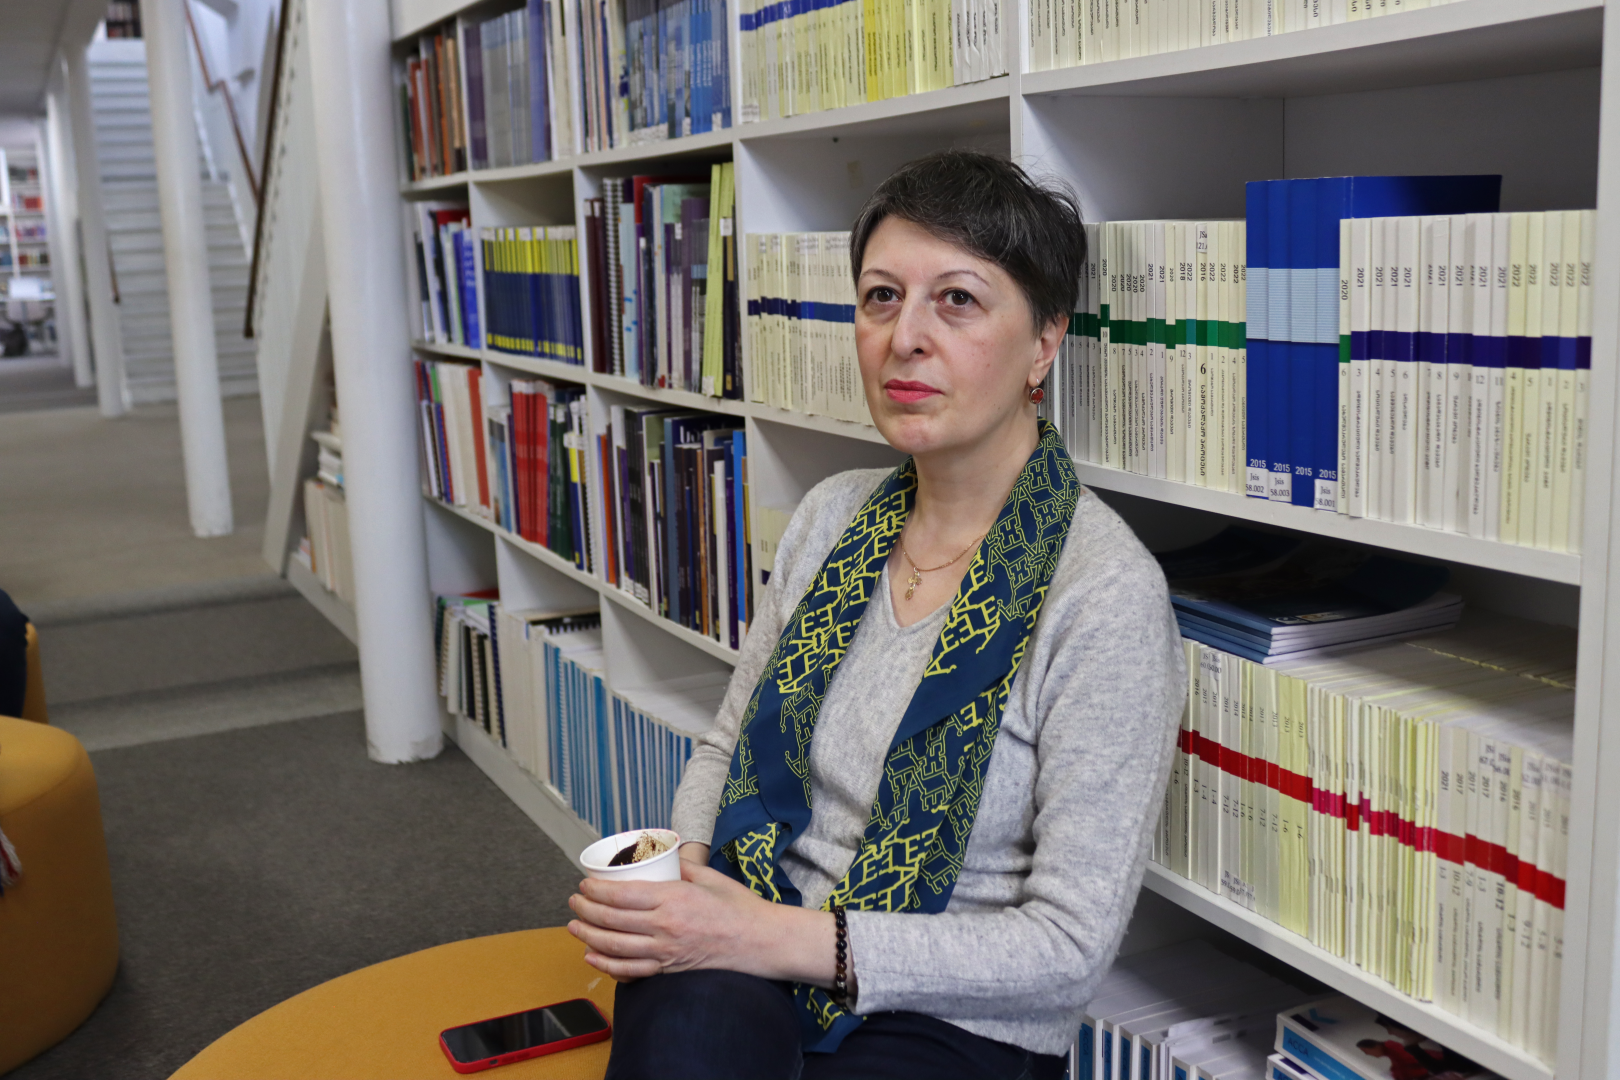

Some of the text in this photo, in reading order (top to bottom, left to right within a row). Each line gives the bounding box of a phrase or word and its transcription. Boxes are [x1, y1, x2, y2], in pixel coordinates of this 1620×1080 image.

[1375, 267, 1383, 287] 2021
[1404, 267, 1412, 287] 2021
[1438, 265, 1446, 286] 2021
[1455, 265, 1464, 286] 2021
[1479, 266, 1487, 287] 2021
[1497, 266, 1507, 288] 2021
[1512, 264, 1521, 287] 2022
[1528, 264, 1537, 285] 2022
[1250, 458, 1266, 468] 2015
[1273, 463, 1290, 472] 2015
[1295, 466, 1312, 476] 2015
[1250, 473, 1260, 481] Jsis
[1274, 478, 1284, 486] Jsis
[1319, 469, 1336, 479] 2015
[1246, 484, 1264, 493] 58.002
[1270, 489, 1290, 497] 58.003
[1320, 486, 1331, 495] Jsis
[1315, 498, 1335, 507] 58.001
[1441, 770, 1449, 791] 2021
[1456, 773, 1464, 795] 2017
[1482, 776, 1490, 798] 2017
[1287, 1037, 1309, 1057] ACCA
